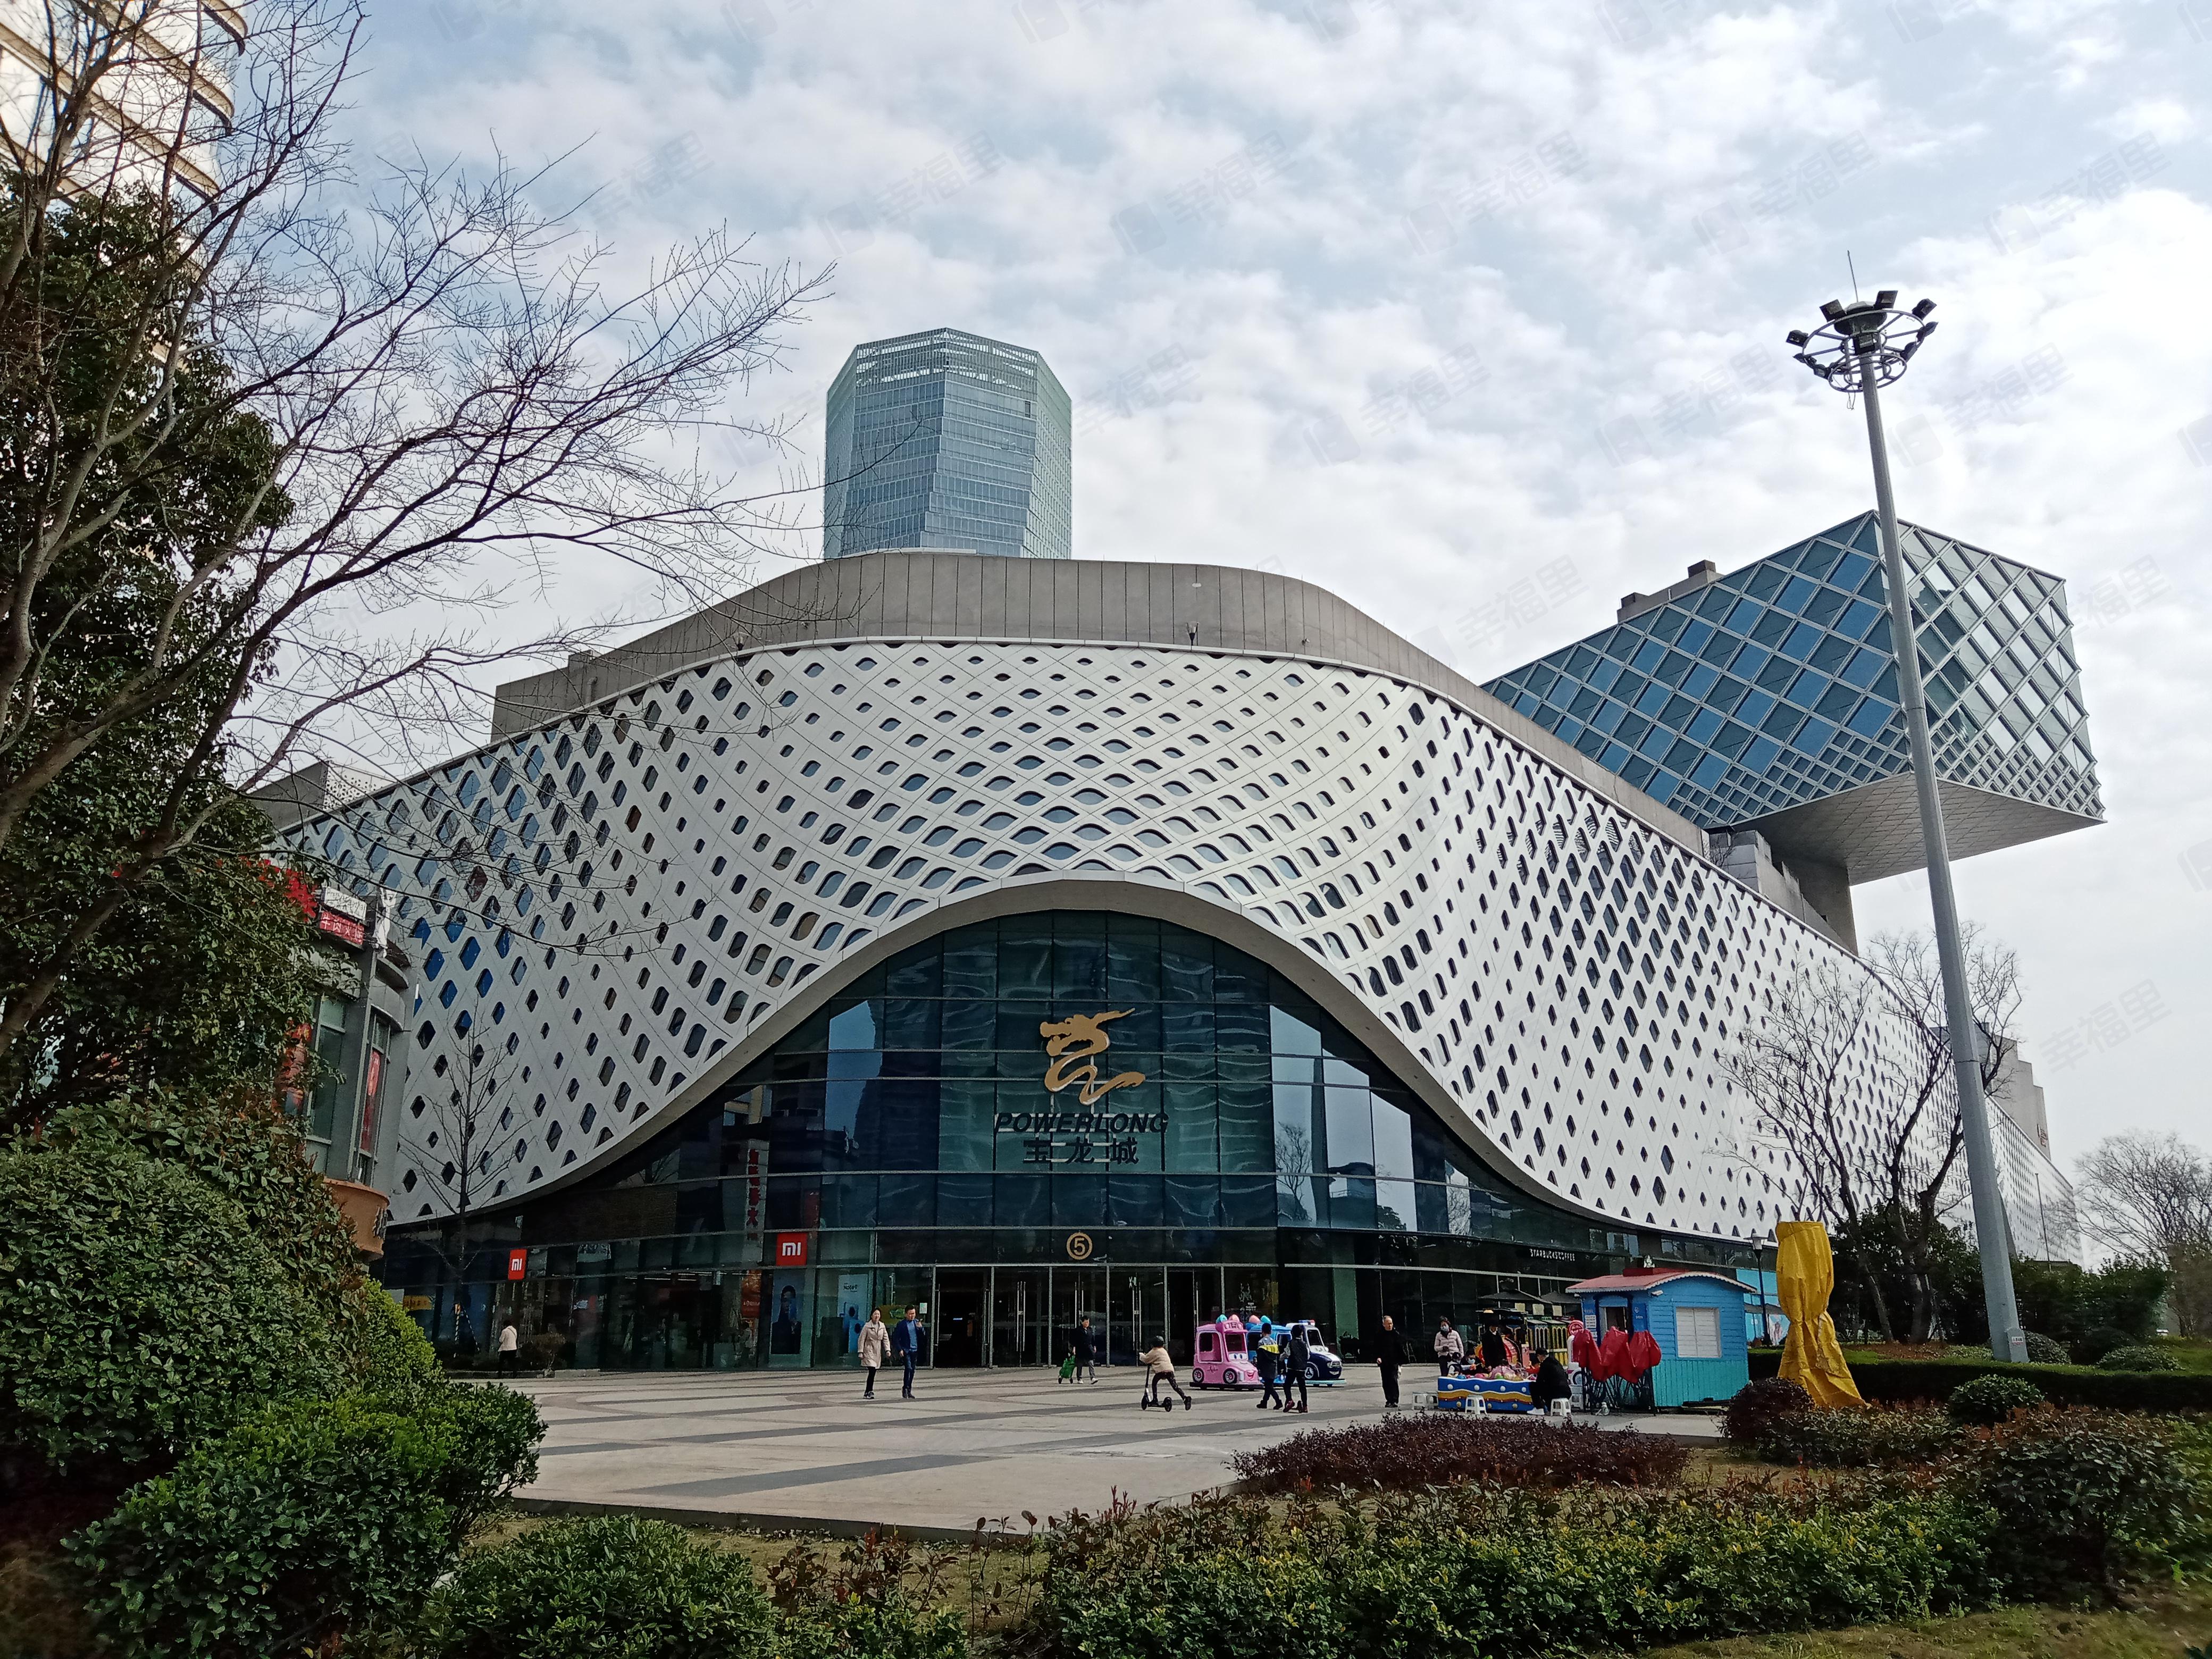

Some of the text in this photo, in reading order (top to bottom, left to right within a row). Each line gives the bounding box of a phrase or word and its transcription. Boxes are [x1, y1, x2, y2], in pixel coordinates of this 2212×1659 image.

[995, 1112, 1169, 1133] POWERLONG
[1023, 1136, 1139, 1164] 宝龙城
